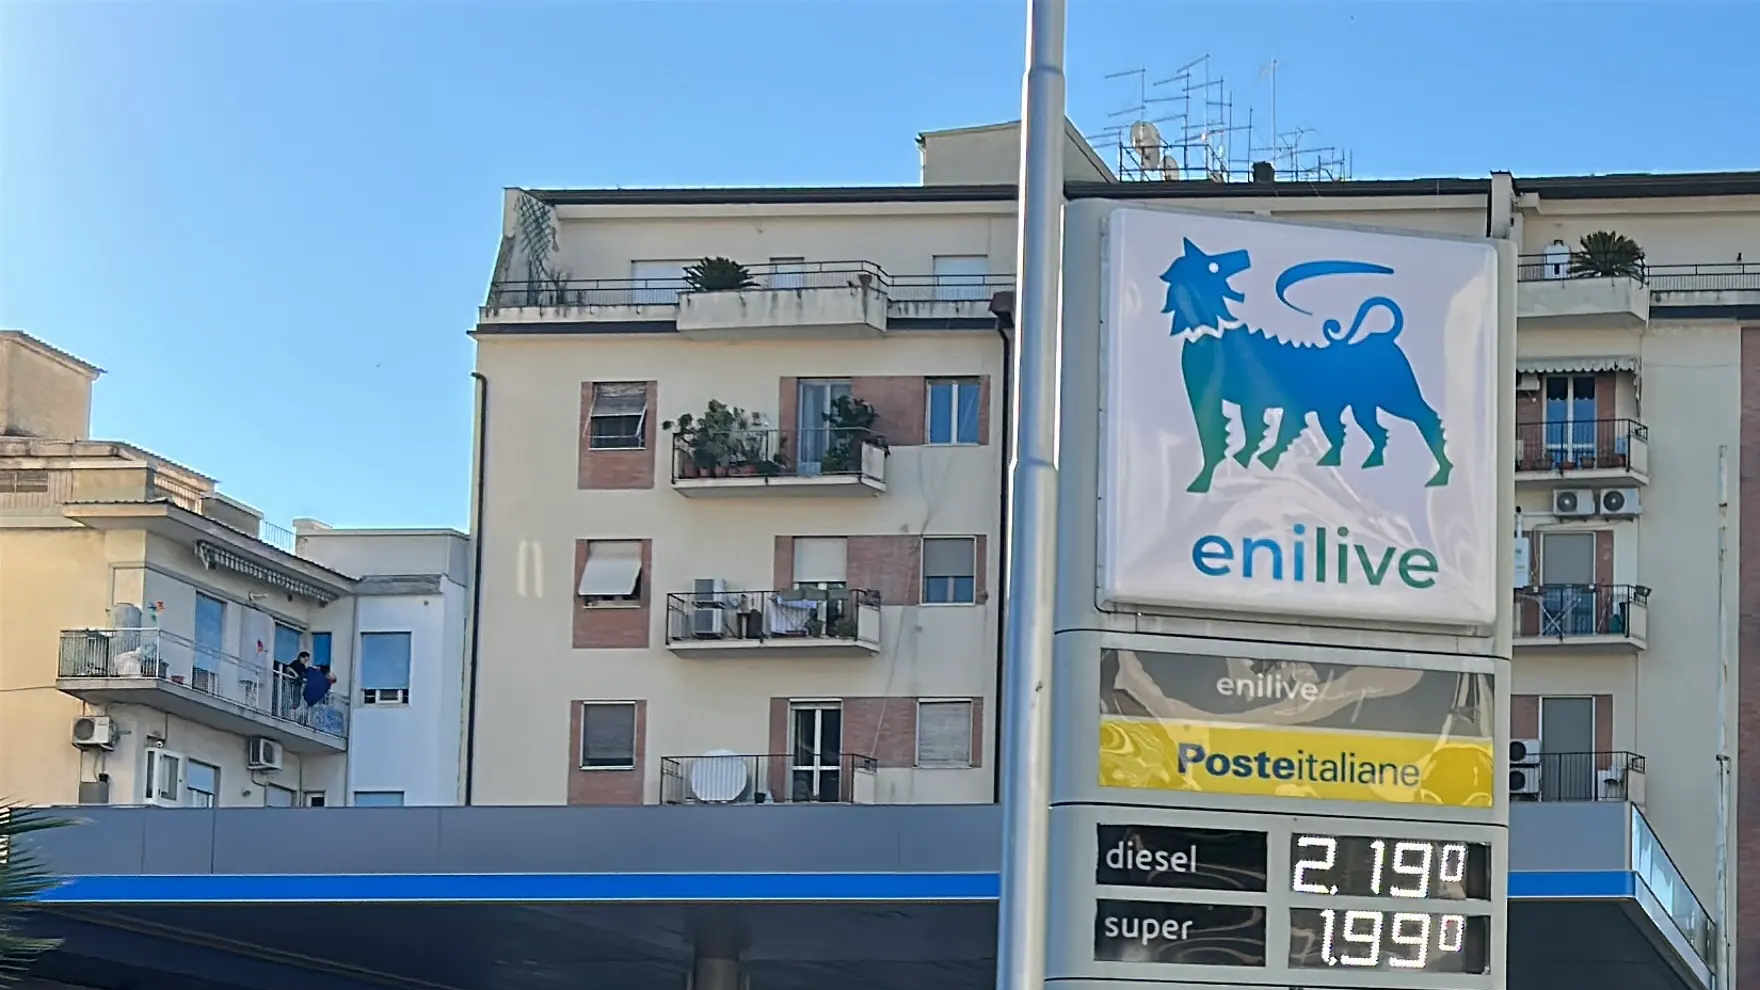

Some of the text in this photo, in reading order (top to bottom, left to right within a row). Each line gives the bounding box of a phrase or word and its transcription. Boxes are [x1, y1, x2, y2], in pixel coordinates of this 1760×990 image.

[1192, 523, 1439, 589] enilive
[1216, 670, 1319, 701] enilive
[1106, 841, 1197, 873] diesel
[1104, 915, 1194, 946] super
